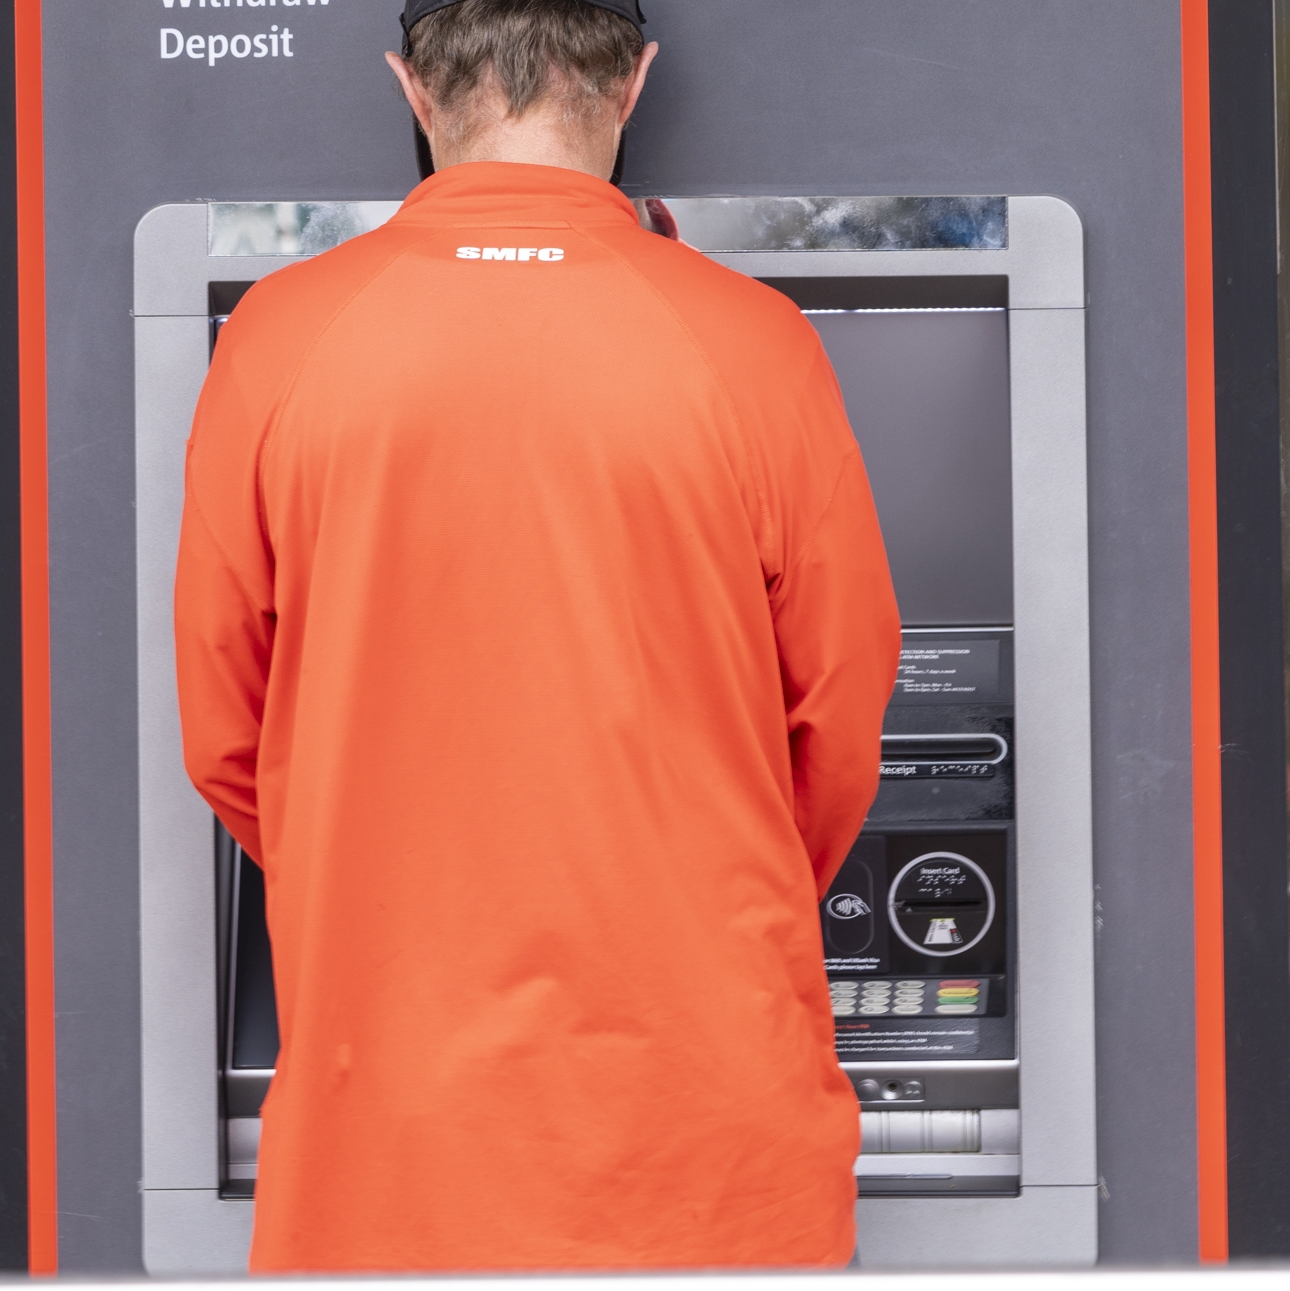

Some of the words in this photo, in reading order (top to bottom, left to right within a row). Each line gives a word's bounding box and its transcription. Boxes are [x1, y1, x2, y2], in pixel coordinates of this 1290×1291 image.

[158, 24, 294, 66] Deposit
[456, 245, 565, 262] SMFC
[878, 765, 917, 776] Receipt
